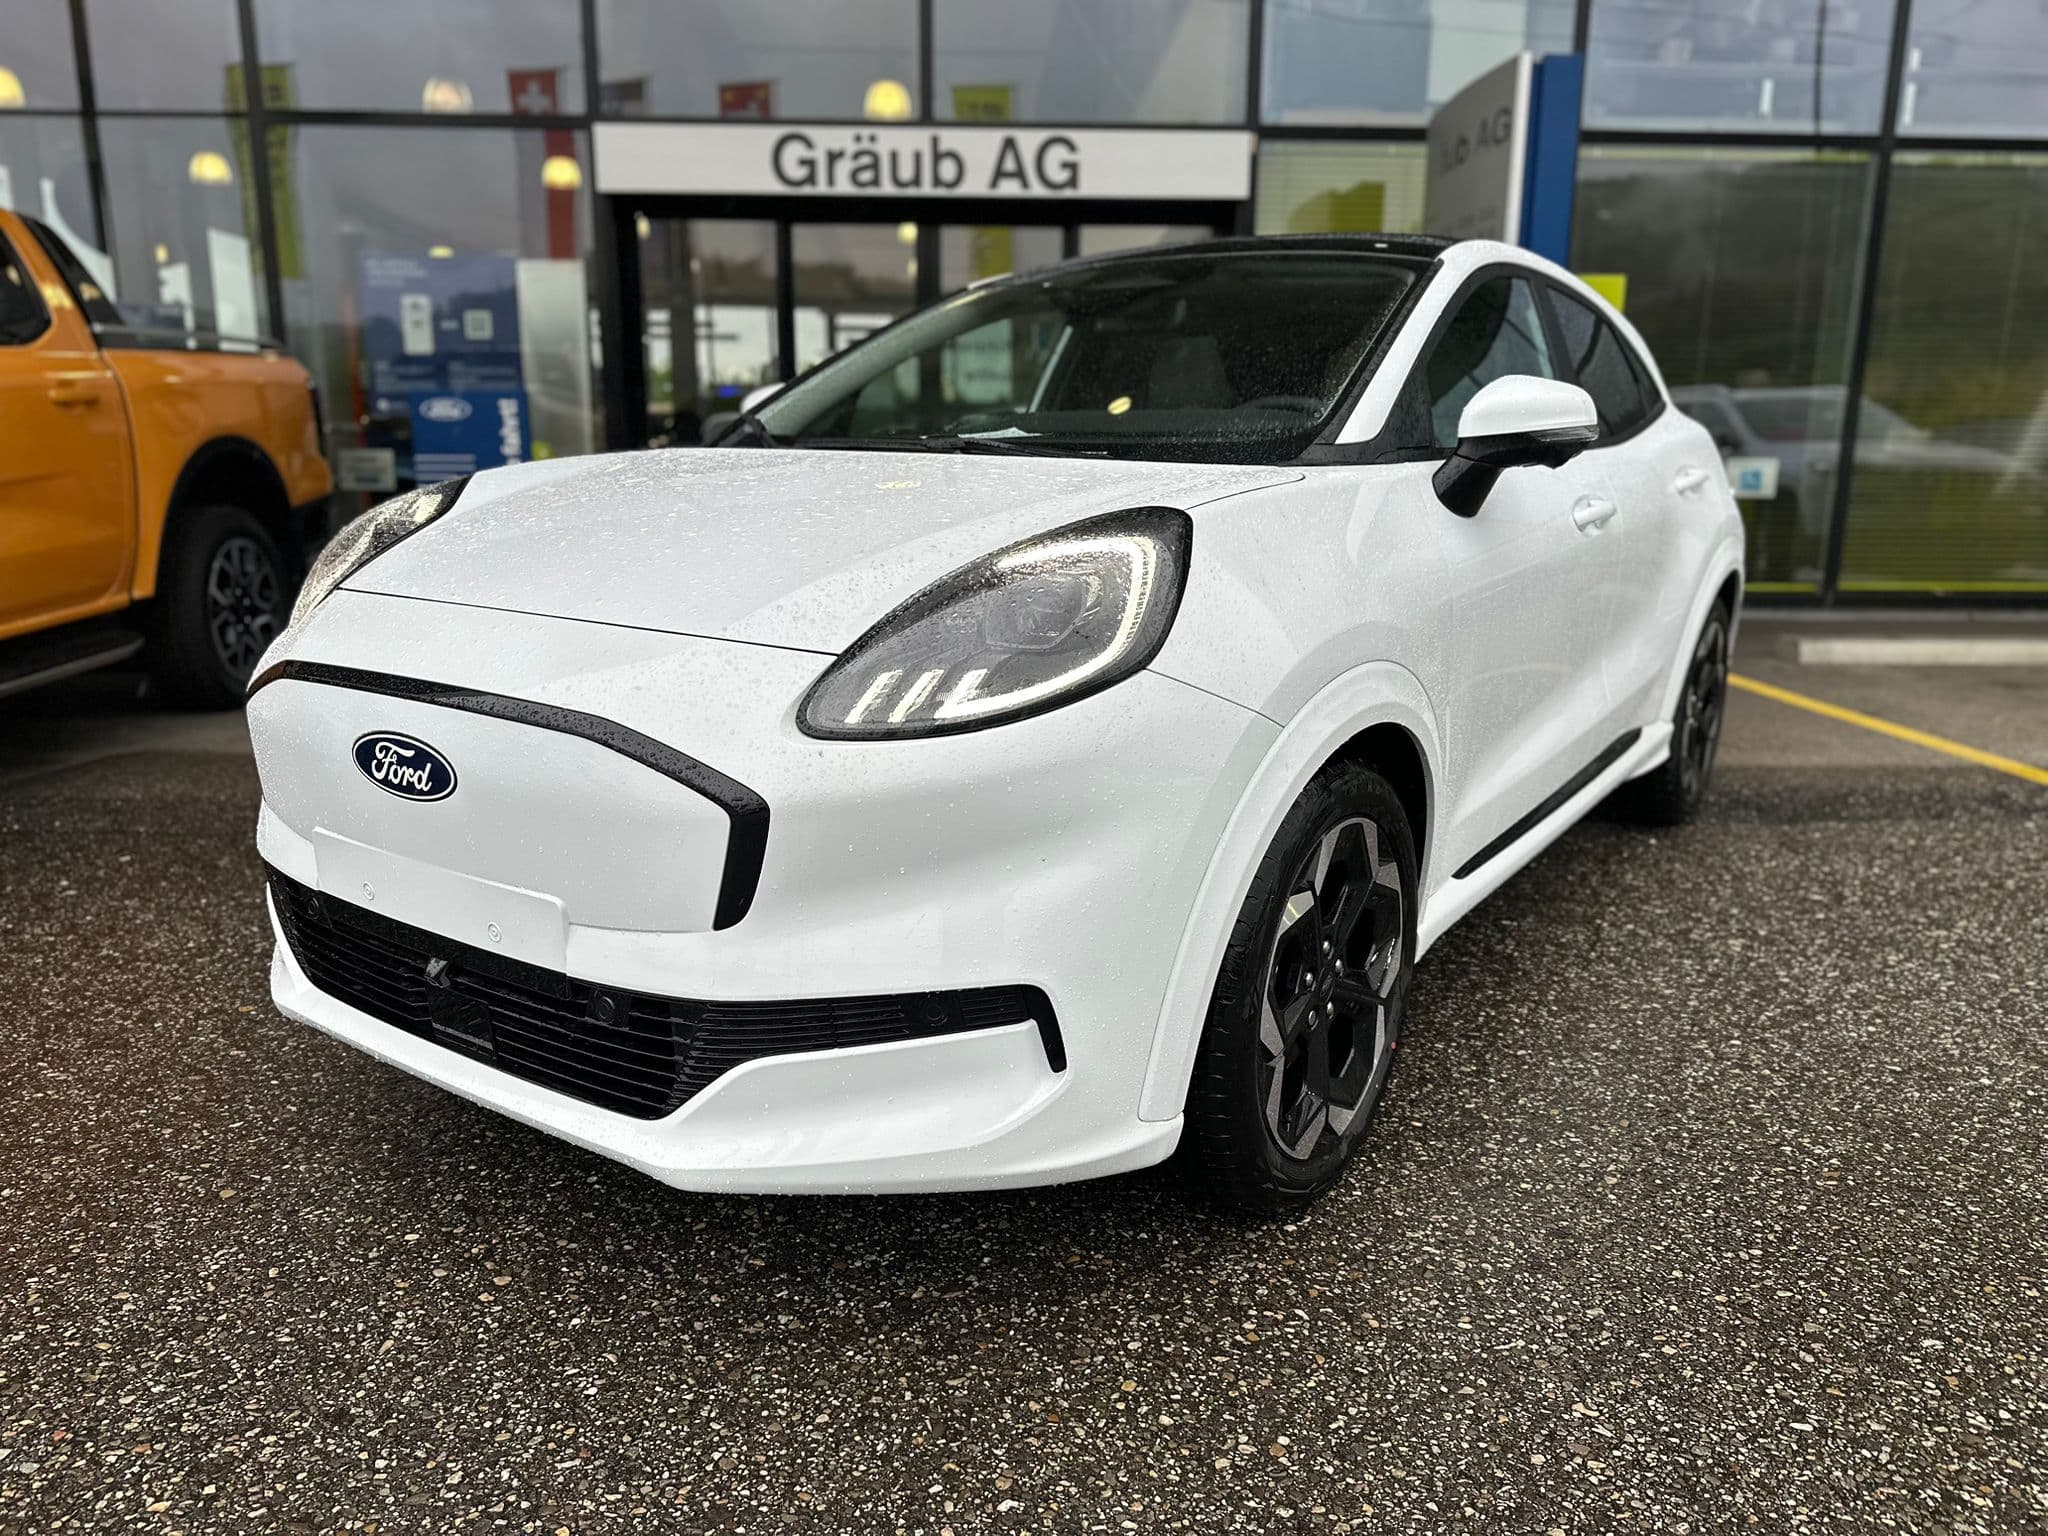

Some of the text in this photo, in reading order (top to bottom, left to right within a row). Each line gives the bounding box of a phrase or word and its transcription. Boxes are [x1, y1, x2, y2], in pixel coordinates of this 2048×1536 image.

[772, 132, 1079, 191] Gräub AG
[371, 741, 433, 791] Ford
